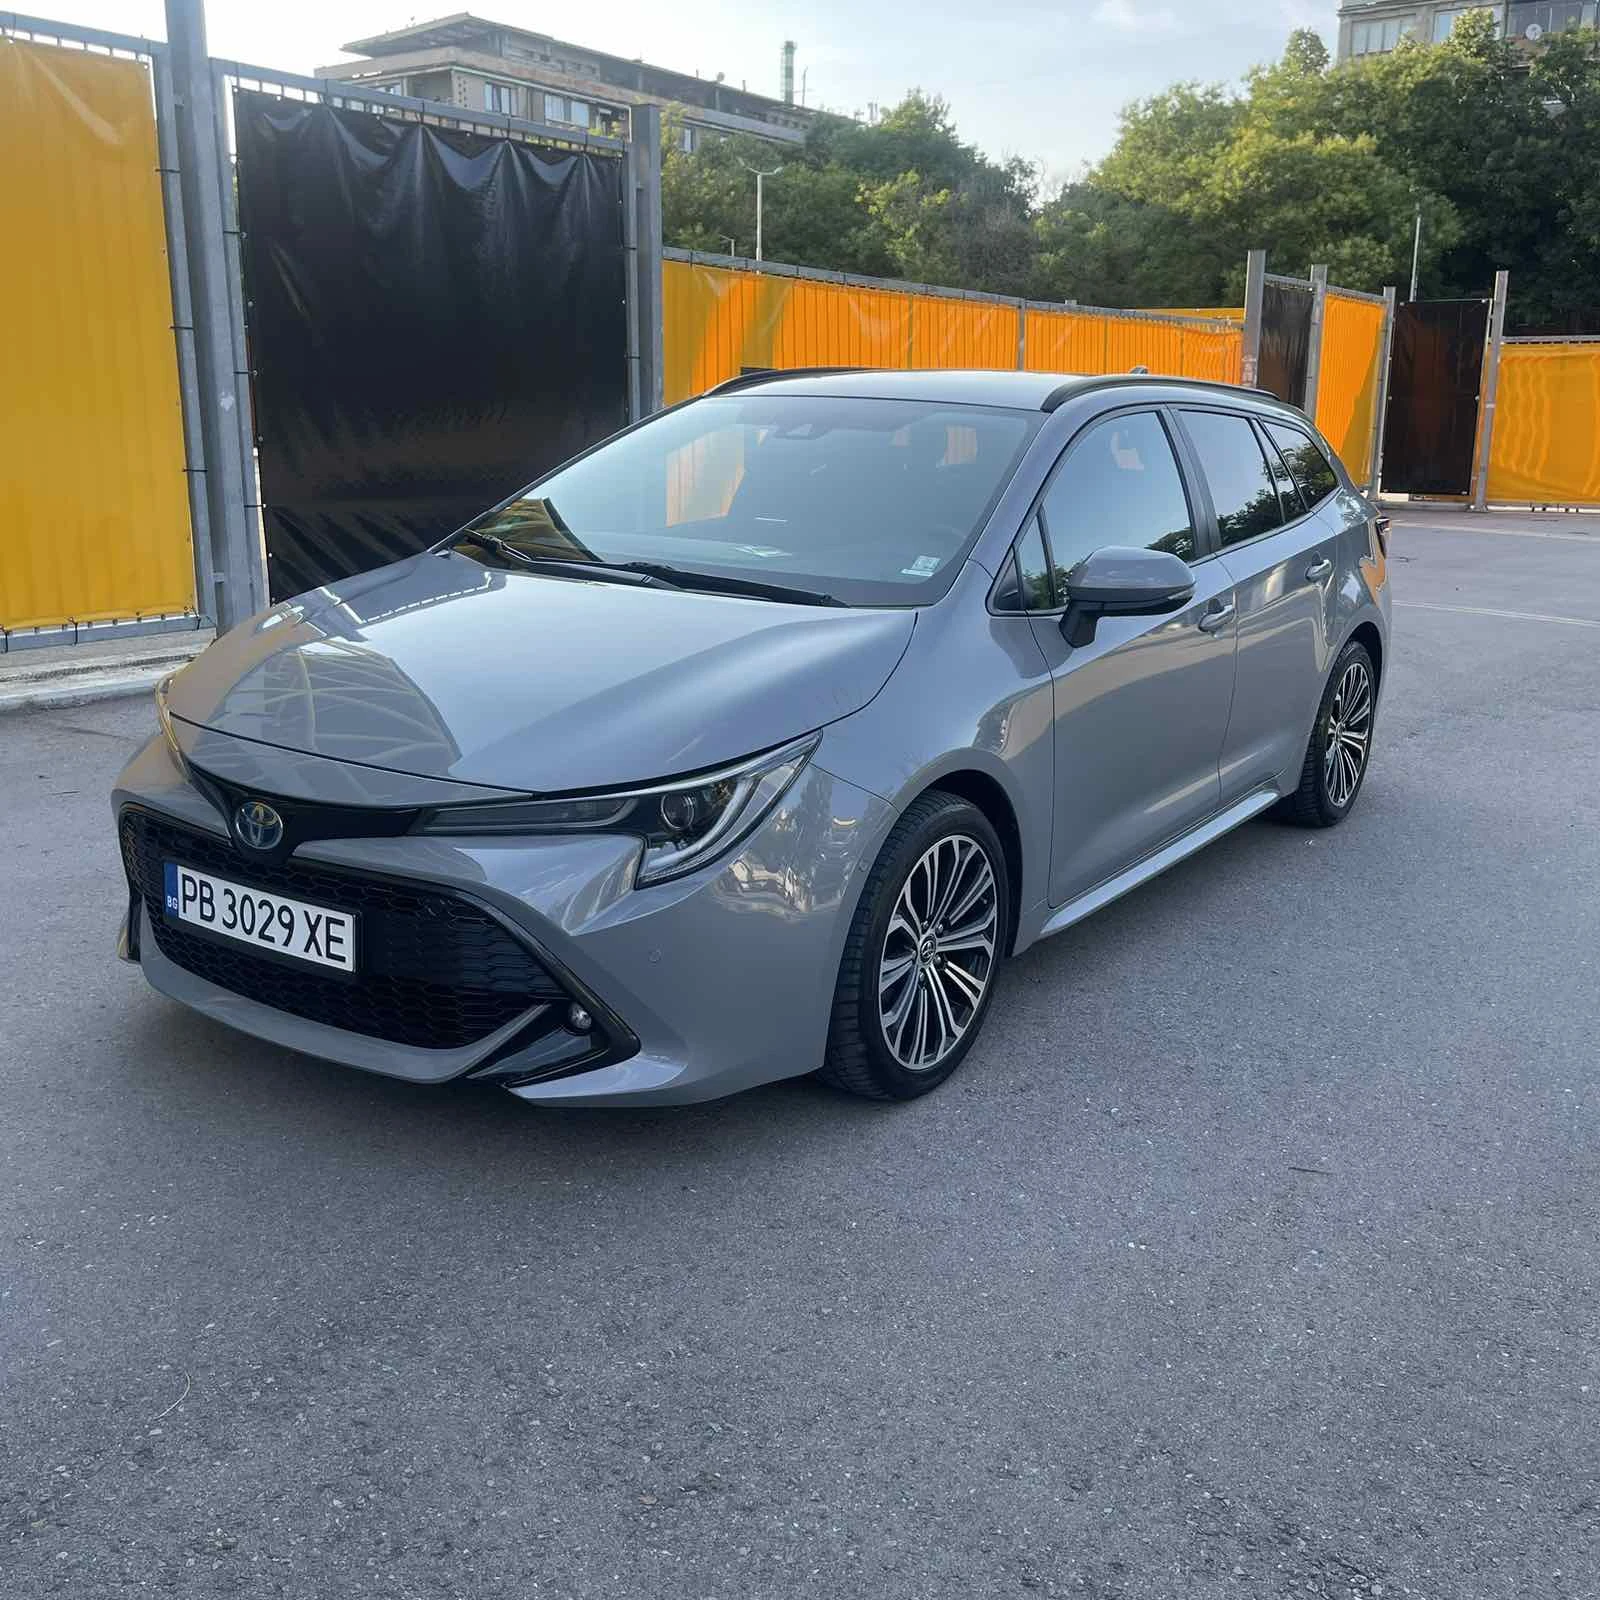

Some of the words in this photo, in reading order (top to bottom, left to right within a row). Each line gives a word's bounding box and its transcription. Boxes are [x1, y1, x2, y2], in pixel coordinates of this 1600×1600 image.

[166, 895, 178, 910] BG
[181, 873, 216, 922] PB
[222, 888, 295, 947] 3029
[303, 910, 346, 963] XE
